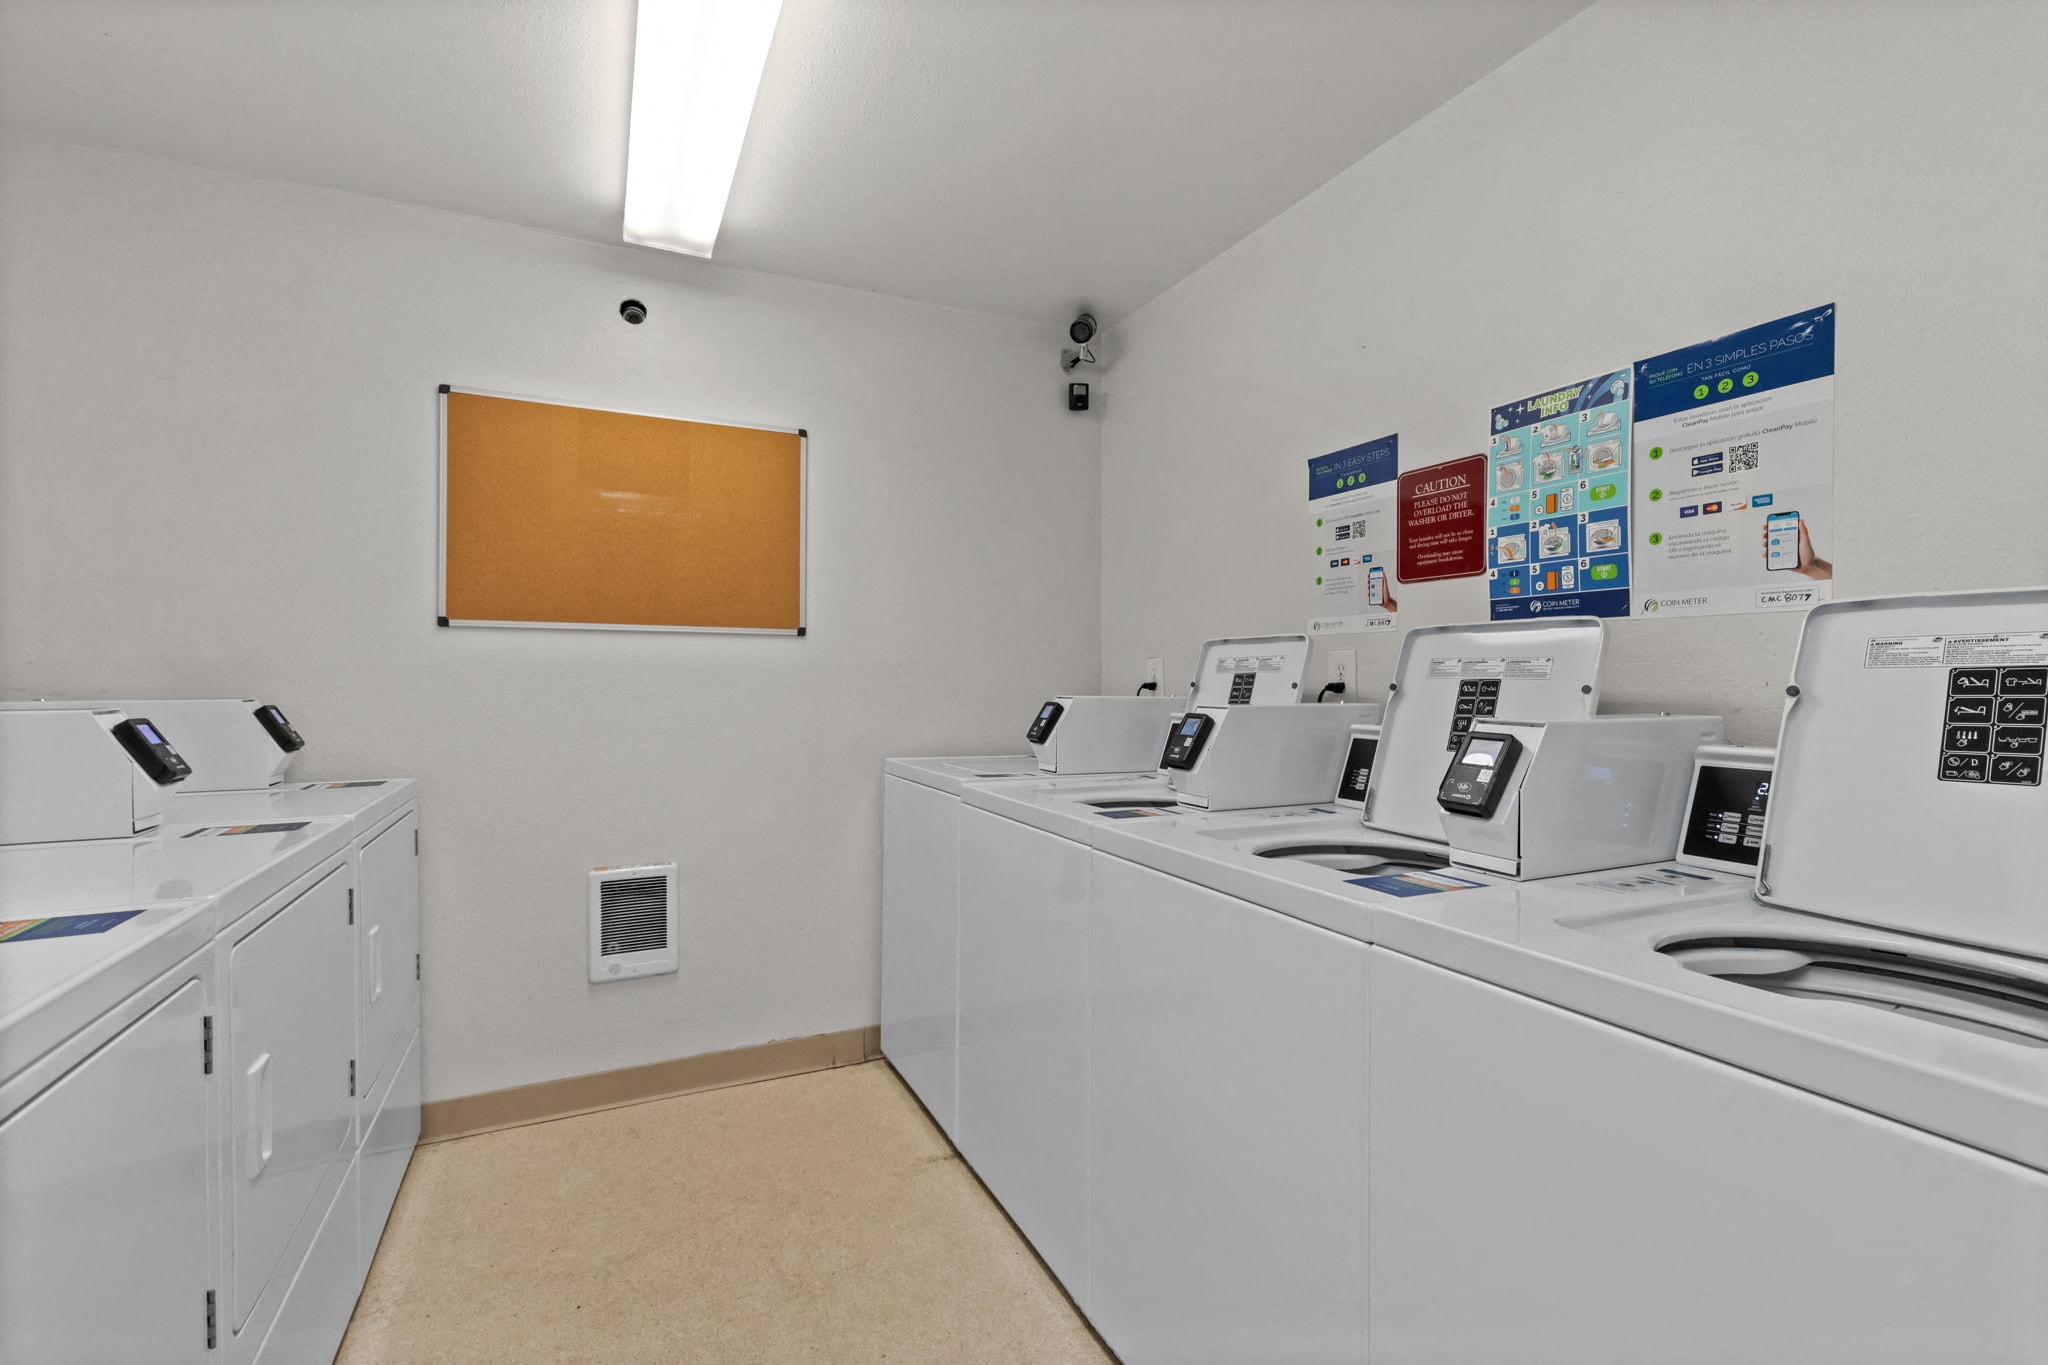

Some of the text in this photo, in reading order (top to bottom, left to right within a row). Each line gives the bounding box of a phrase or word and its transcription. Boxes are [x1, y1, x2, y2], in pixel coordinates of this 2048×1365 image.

[1687, 331, 1814, 374] EN 3 SIMPLES PASOS
[1732, 364, 1752, 374] COMO
[1722, 382, 1729, 390] 2
[1748, 375, 1754, 384] 3
[1527, 384, 1584, 412] LAUNDRY
[1540, 400, 1570, 418] INFO
[1582, 414, 1588, 422] 3
[1682, 405, 1764, 428] CleanPay Mobile para pagar
[1653, 450, 1659, 458] 1
[1761, 424, 1794, 435] CleanPay
[1794, 418, 1818, 428] Mobile
[1342, 460, 1347, 468] 3
[1348, 454, 1366, 467] EASY
[1366, 448, 1392, 462] STEPS
[1415, 474, 1466, 494] CAUTION
[1580, 480, 1586, 489] 6
[1532, 490, 1538, 498] 5
[1652, 491, 1659, 500] 2
[1414, 492, 1468, 509] PLEASE DO NOT
[1413, 500, 1468, 518] OVERLOAD THE
[1408, 516, 1436, 527] WASHER
[1580, 514, 1586, 522] 3
[1652, 534, 1659, 543] 3
[1417, 551, 1442, 560] Overloading
[1580, 560, 1586, 568] 6
[1560, 598, 1580, 606] METER
[1660, 597, 1708, 607] COIN METER
